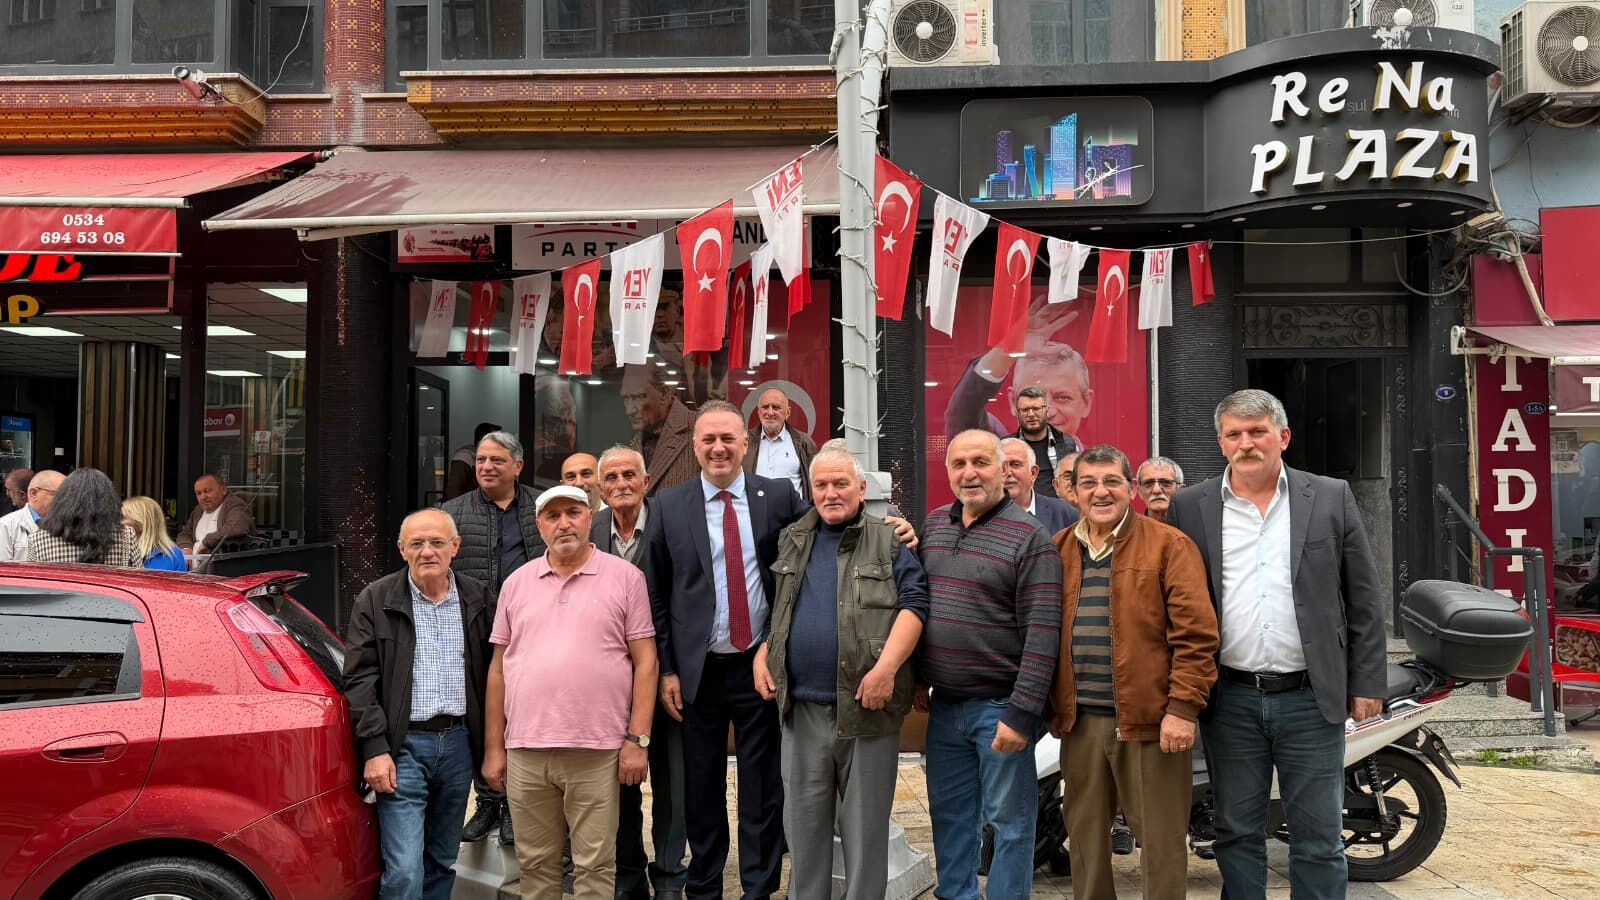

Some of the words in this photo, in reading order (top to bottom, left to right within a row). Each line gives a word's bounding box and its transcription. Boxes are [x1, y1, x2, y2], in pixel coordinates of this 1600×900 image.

[1249, 129, 1479, 194] PLAZA
[62, 213, 105, 226] 0534
[40, 231, 72, 244] 694
[76, 231, 98, 244] 53
[103, 231, 125, 244] 08
[541, 241, 630, 256] PART
[1489, 351, 1538, 617] TADI
